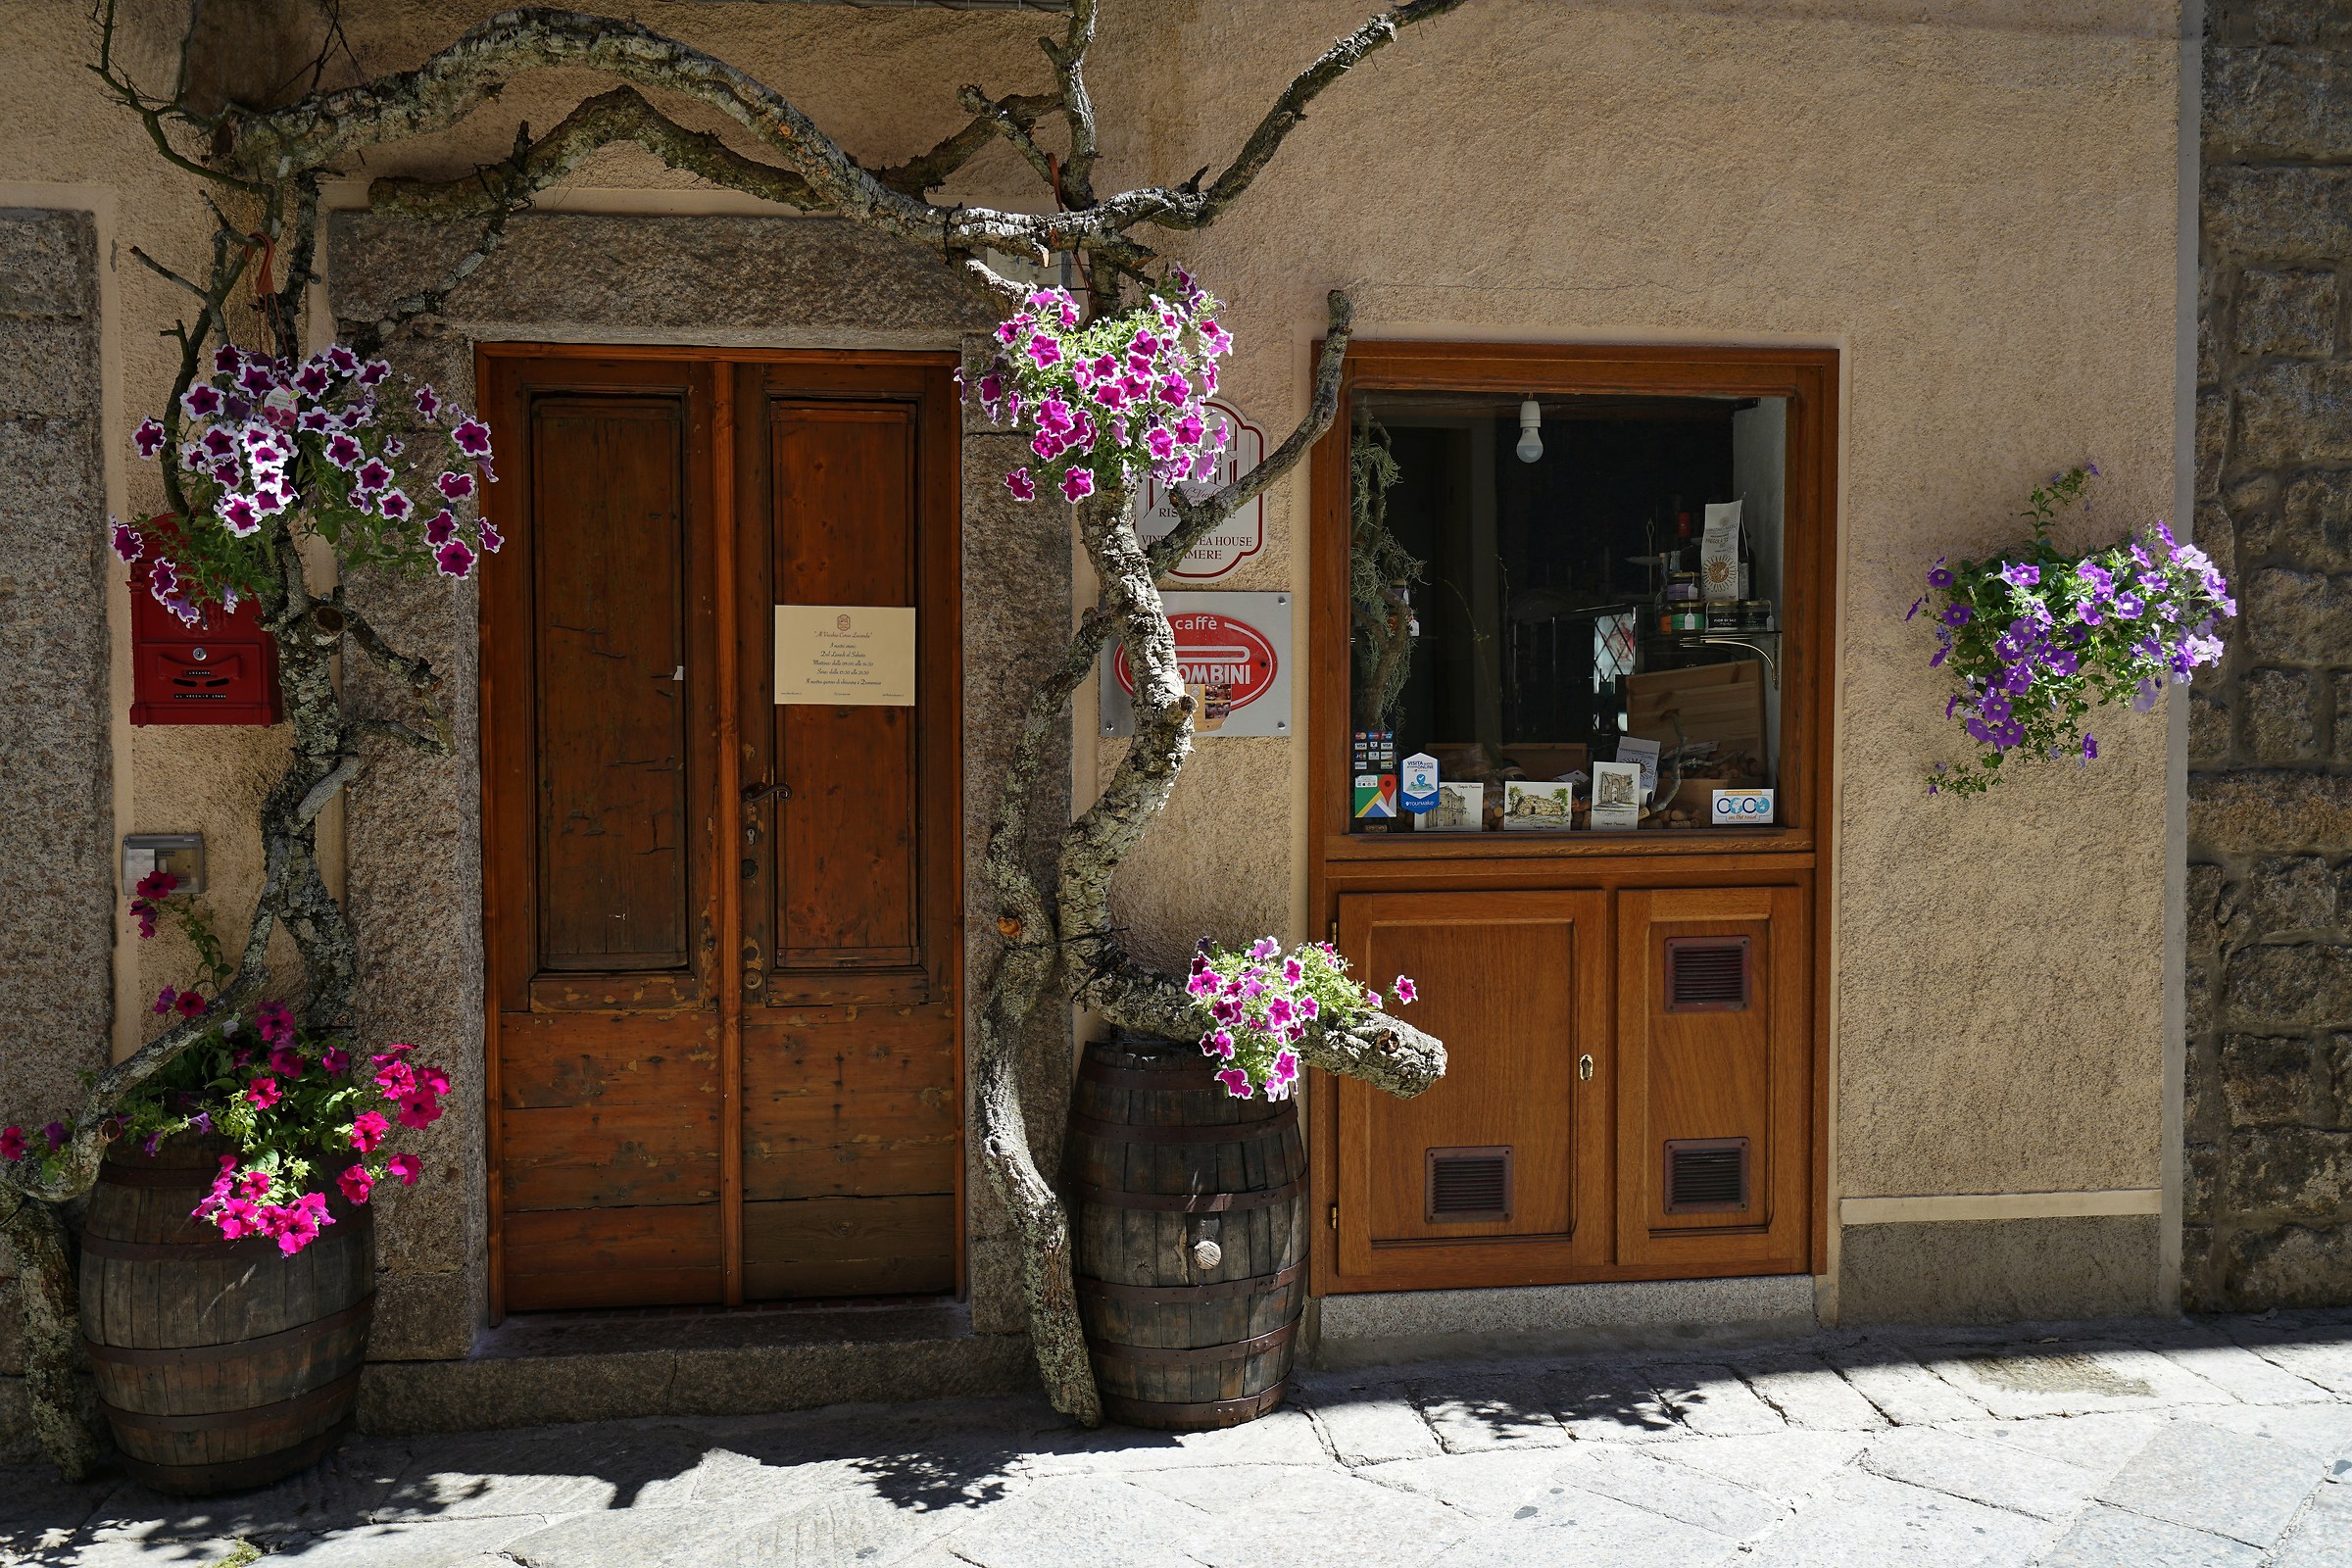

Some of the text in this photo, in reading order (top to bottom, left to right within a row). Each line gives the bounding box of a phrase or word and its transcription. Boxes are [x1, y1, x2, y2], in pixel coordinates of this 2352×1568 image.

[1215, 537, 1252, 547] HOUSE
[1184, 550, 1222, 560] AMERE
[1175, 616, 1217, 630] caffè
